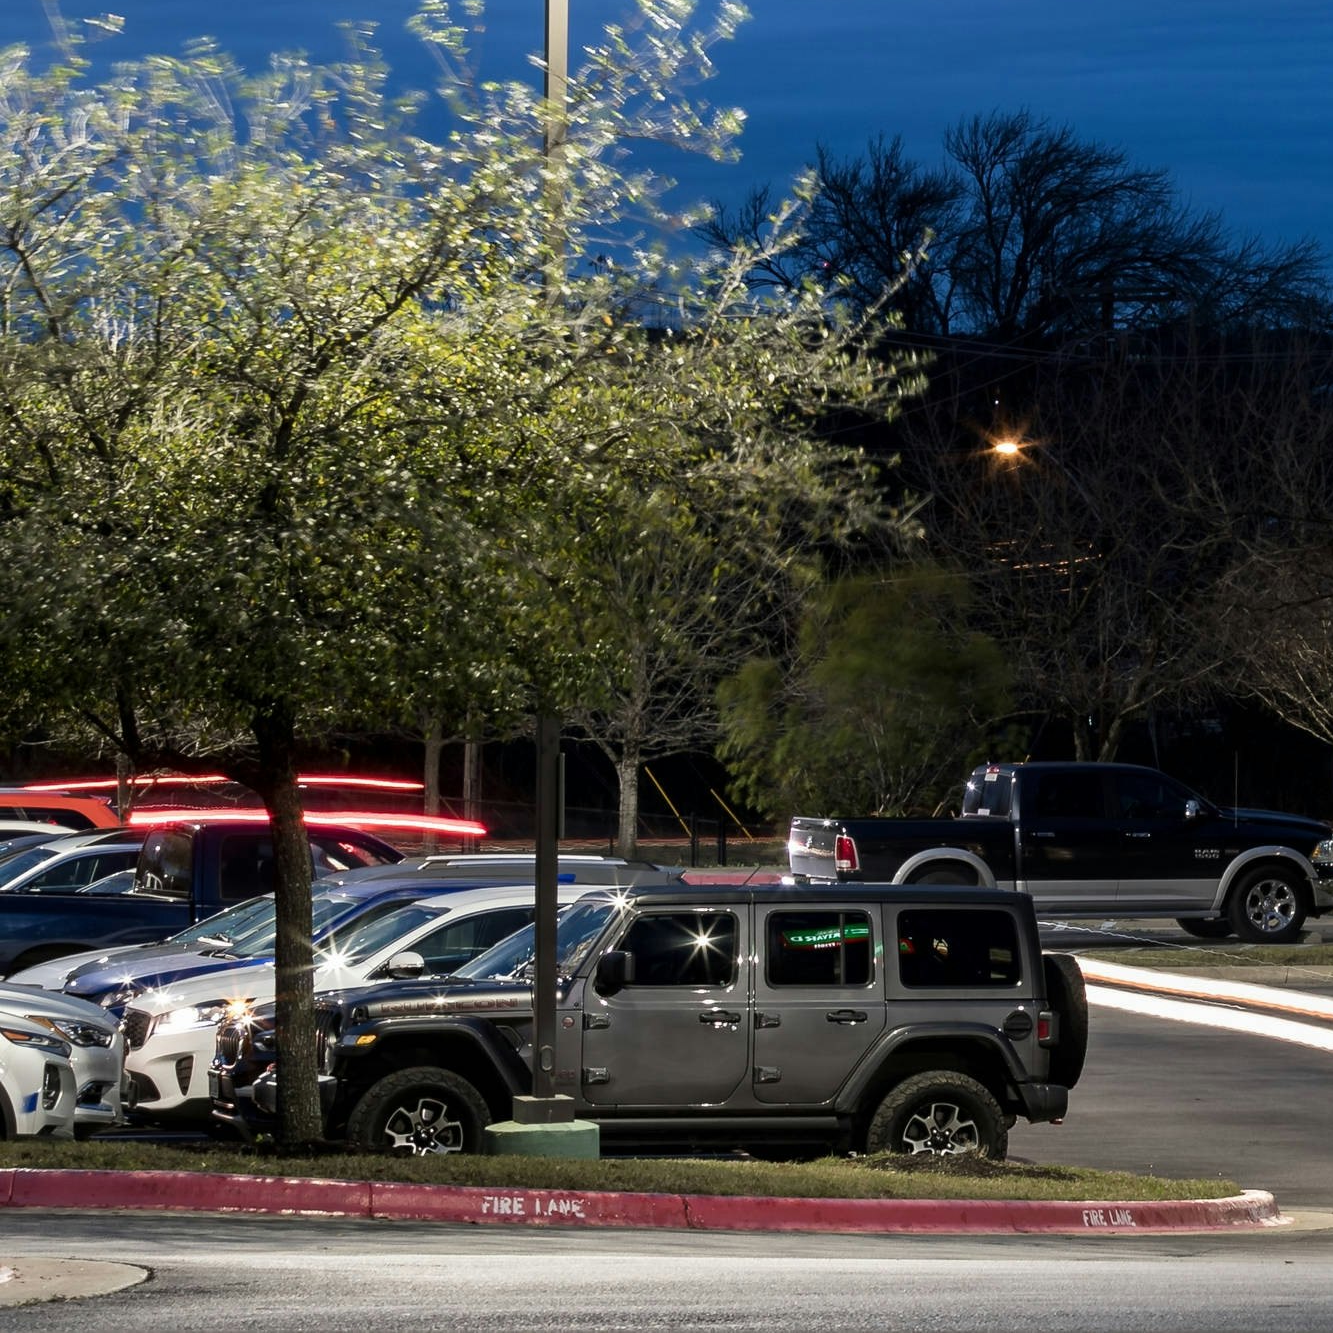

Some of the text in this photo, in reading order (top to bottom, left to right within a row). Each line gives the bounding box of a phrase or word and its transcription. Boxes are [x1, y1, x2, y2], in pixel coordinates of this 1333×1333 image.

[381, 998, 518, 1013] RUBCON
[481, 1196, 586, 1218] FIRE LANE
[1082, 1210, 1136, 1226] FIRE LANE
